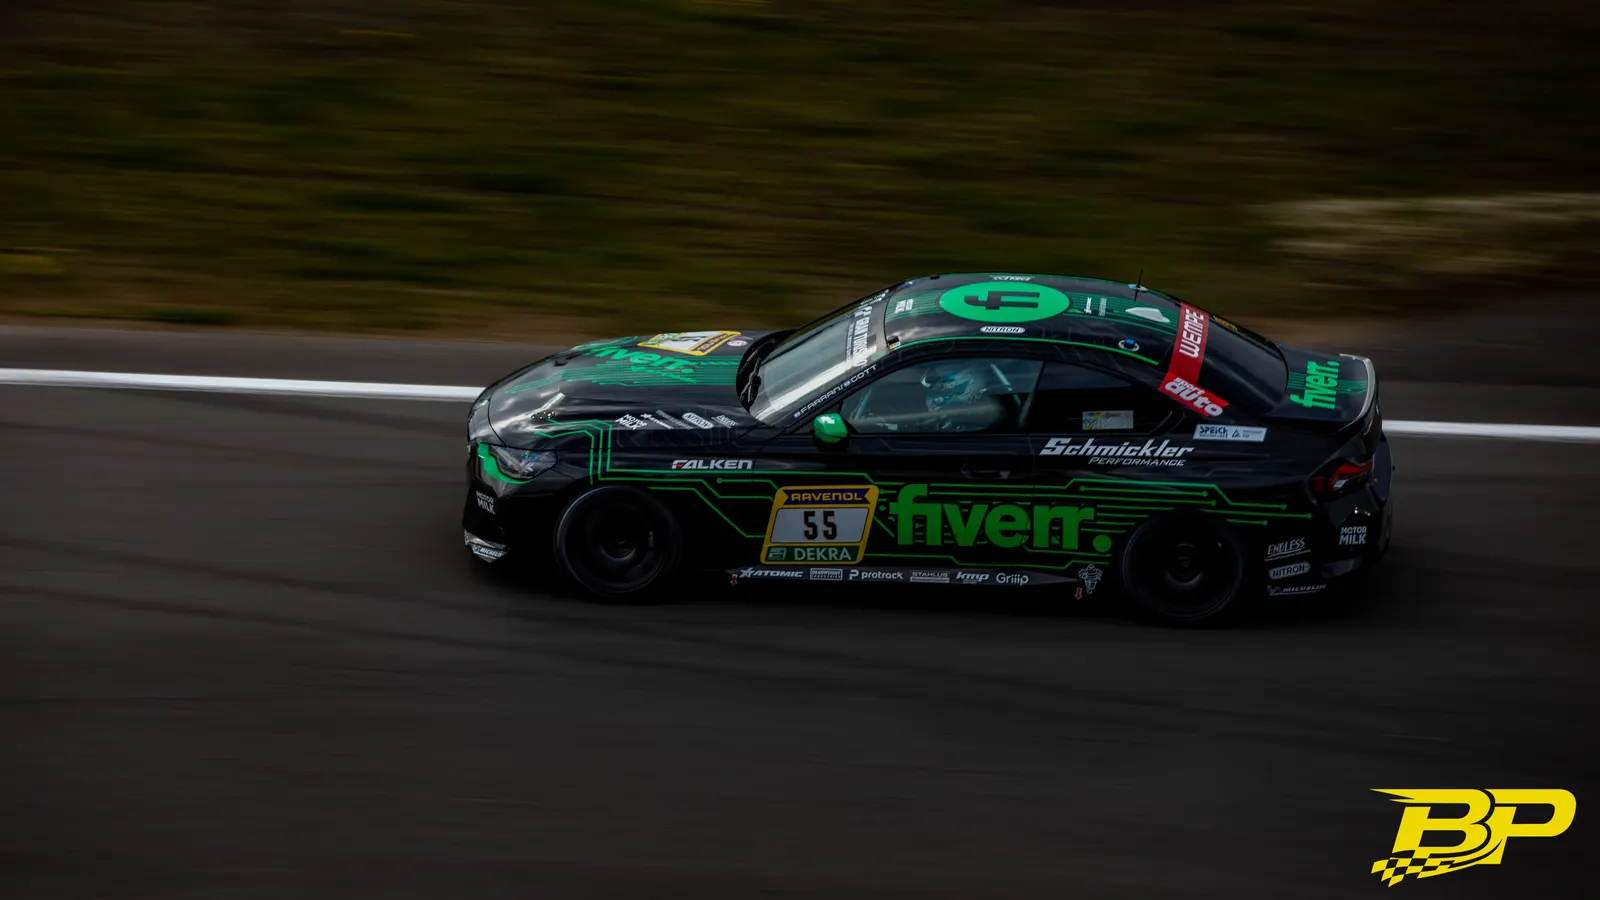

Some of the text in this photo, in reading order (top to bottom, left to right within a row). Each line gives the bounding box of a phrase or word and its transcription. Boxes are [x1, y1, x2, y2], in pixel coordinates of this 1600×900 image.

[1179, 308, 1204, 359] WEMPE
[1289, 360, 1340, 410] fiverr.
[1164, 381, 1223, 417] auto
[1039, 437, 1195, 457] Schmickler
[671, 459, 753, 470] FALKEN
[1088, 457, 1187, 467] PERFORMANCE
[791, 492, 863, 502] RAVENOL
[889, 483, 1112, 553] fiverr.
[804, 510, 837, 540] 55
[1340, 525, 1368, 535] MOTOR
[1339, 533, 1367, 546] MILK
[1267, 537, 1306, 556] ENDLESS
[794, 547, 852, 561] DEKRA
[751, 569, 804, 578] ATOMIC
[861, 571, 903, 580] protrack
[956, 571, 990, 580] kmp
[1272, 563, 1306, 577] NITRON
[995, 572, 1029, 585] Griiip
[1283, 583, 1327, 593] MICHELIN
